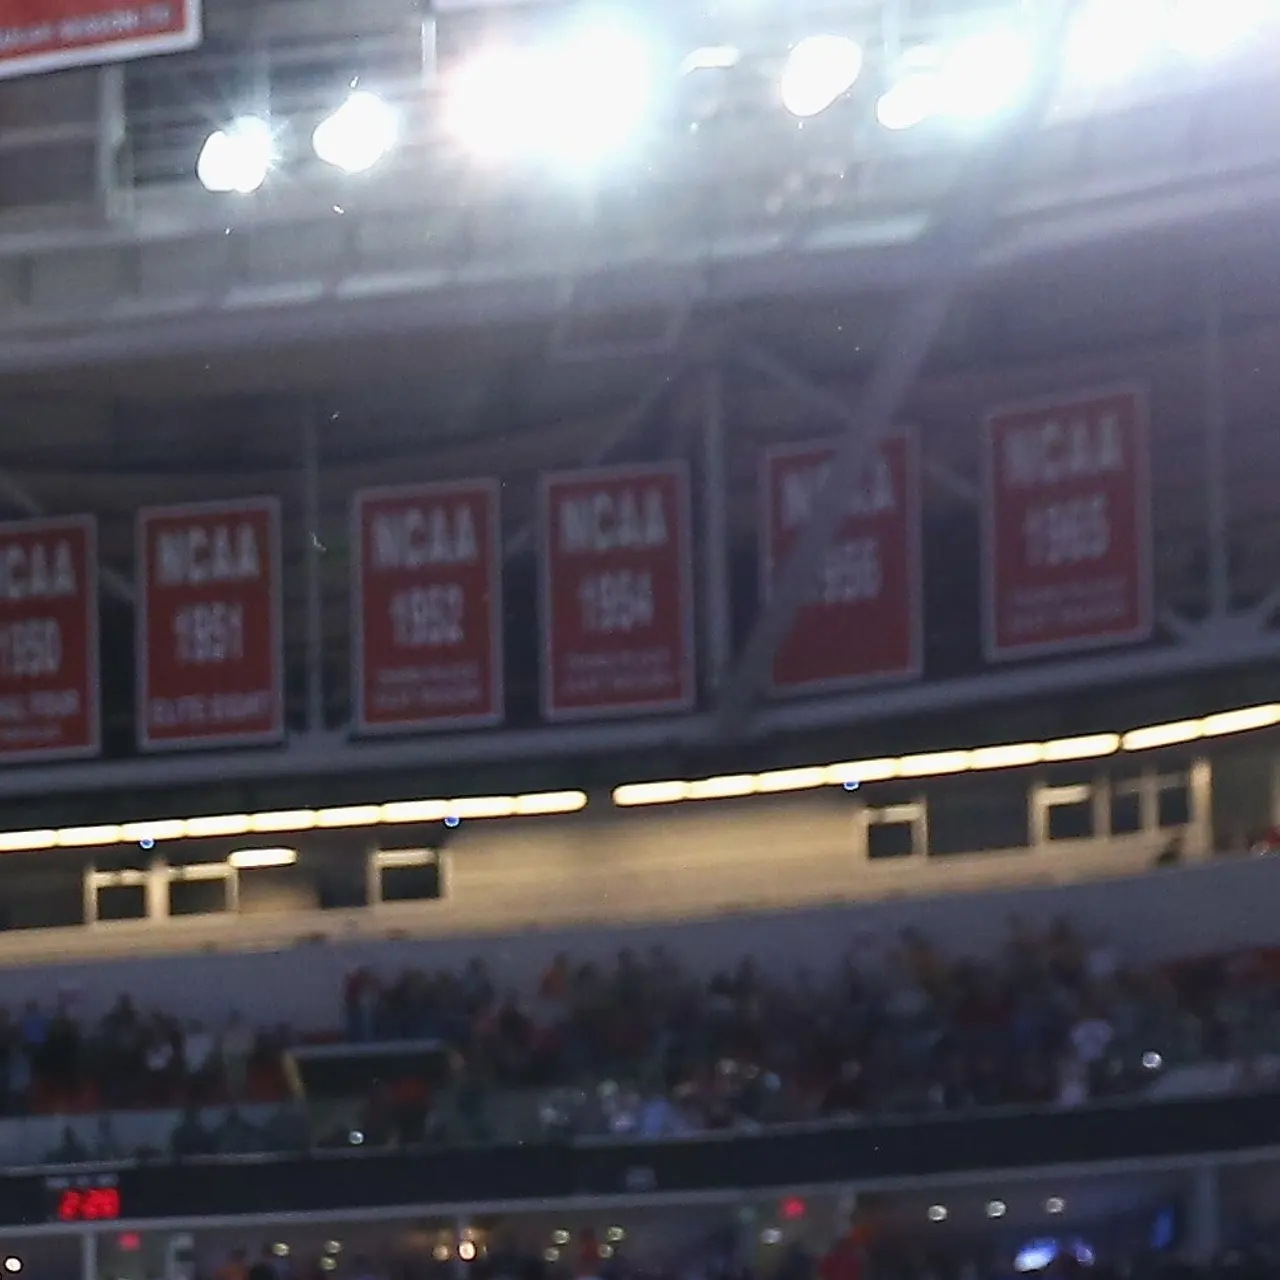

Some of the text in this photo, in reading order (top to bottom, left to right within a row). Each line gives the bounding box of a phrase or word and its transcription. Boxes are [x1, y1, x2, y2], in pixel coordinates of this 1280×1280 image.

[372, 504, 478, 570] NCAA
[559, 489, 668, 554] NCAA
[156, 522, 260, 587] NCAA
